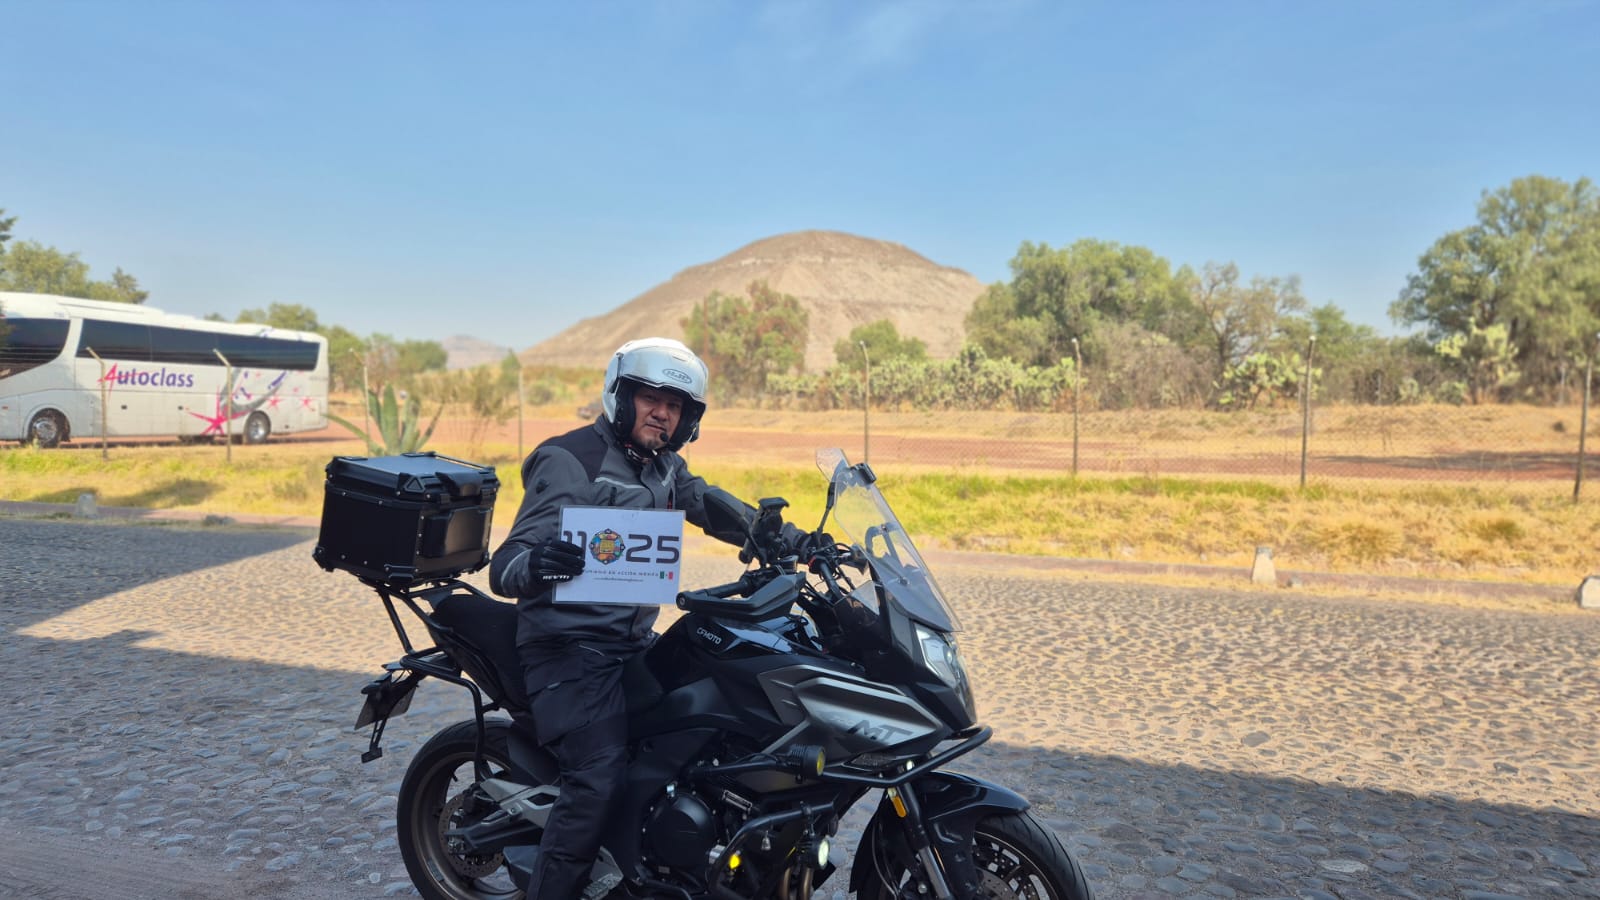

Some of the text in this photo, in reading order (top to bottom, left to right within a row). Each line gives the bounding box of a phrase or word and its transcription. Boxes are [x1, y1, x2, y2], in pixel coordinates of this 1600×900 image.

[97, 363, 194, 392] Autoclass
[625, 533, 680, 564] 25
[696, 627, 722, 645] CFMOTO
[847, 719, 914, 743] MT
